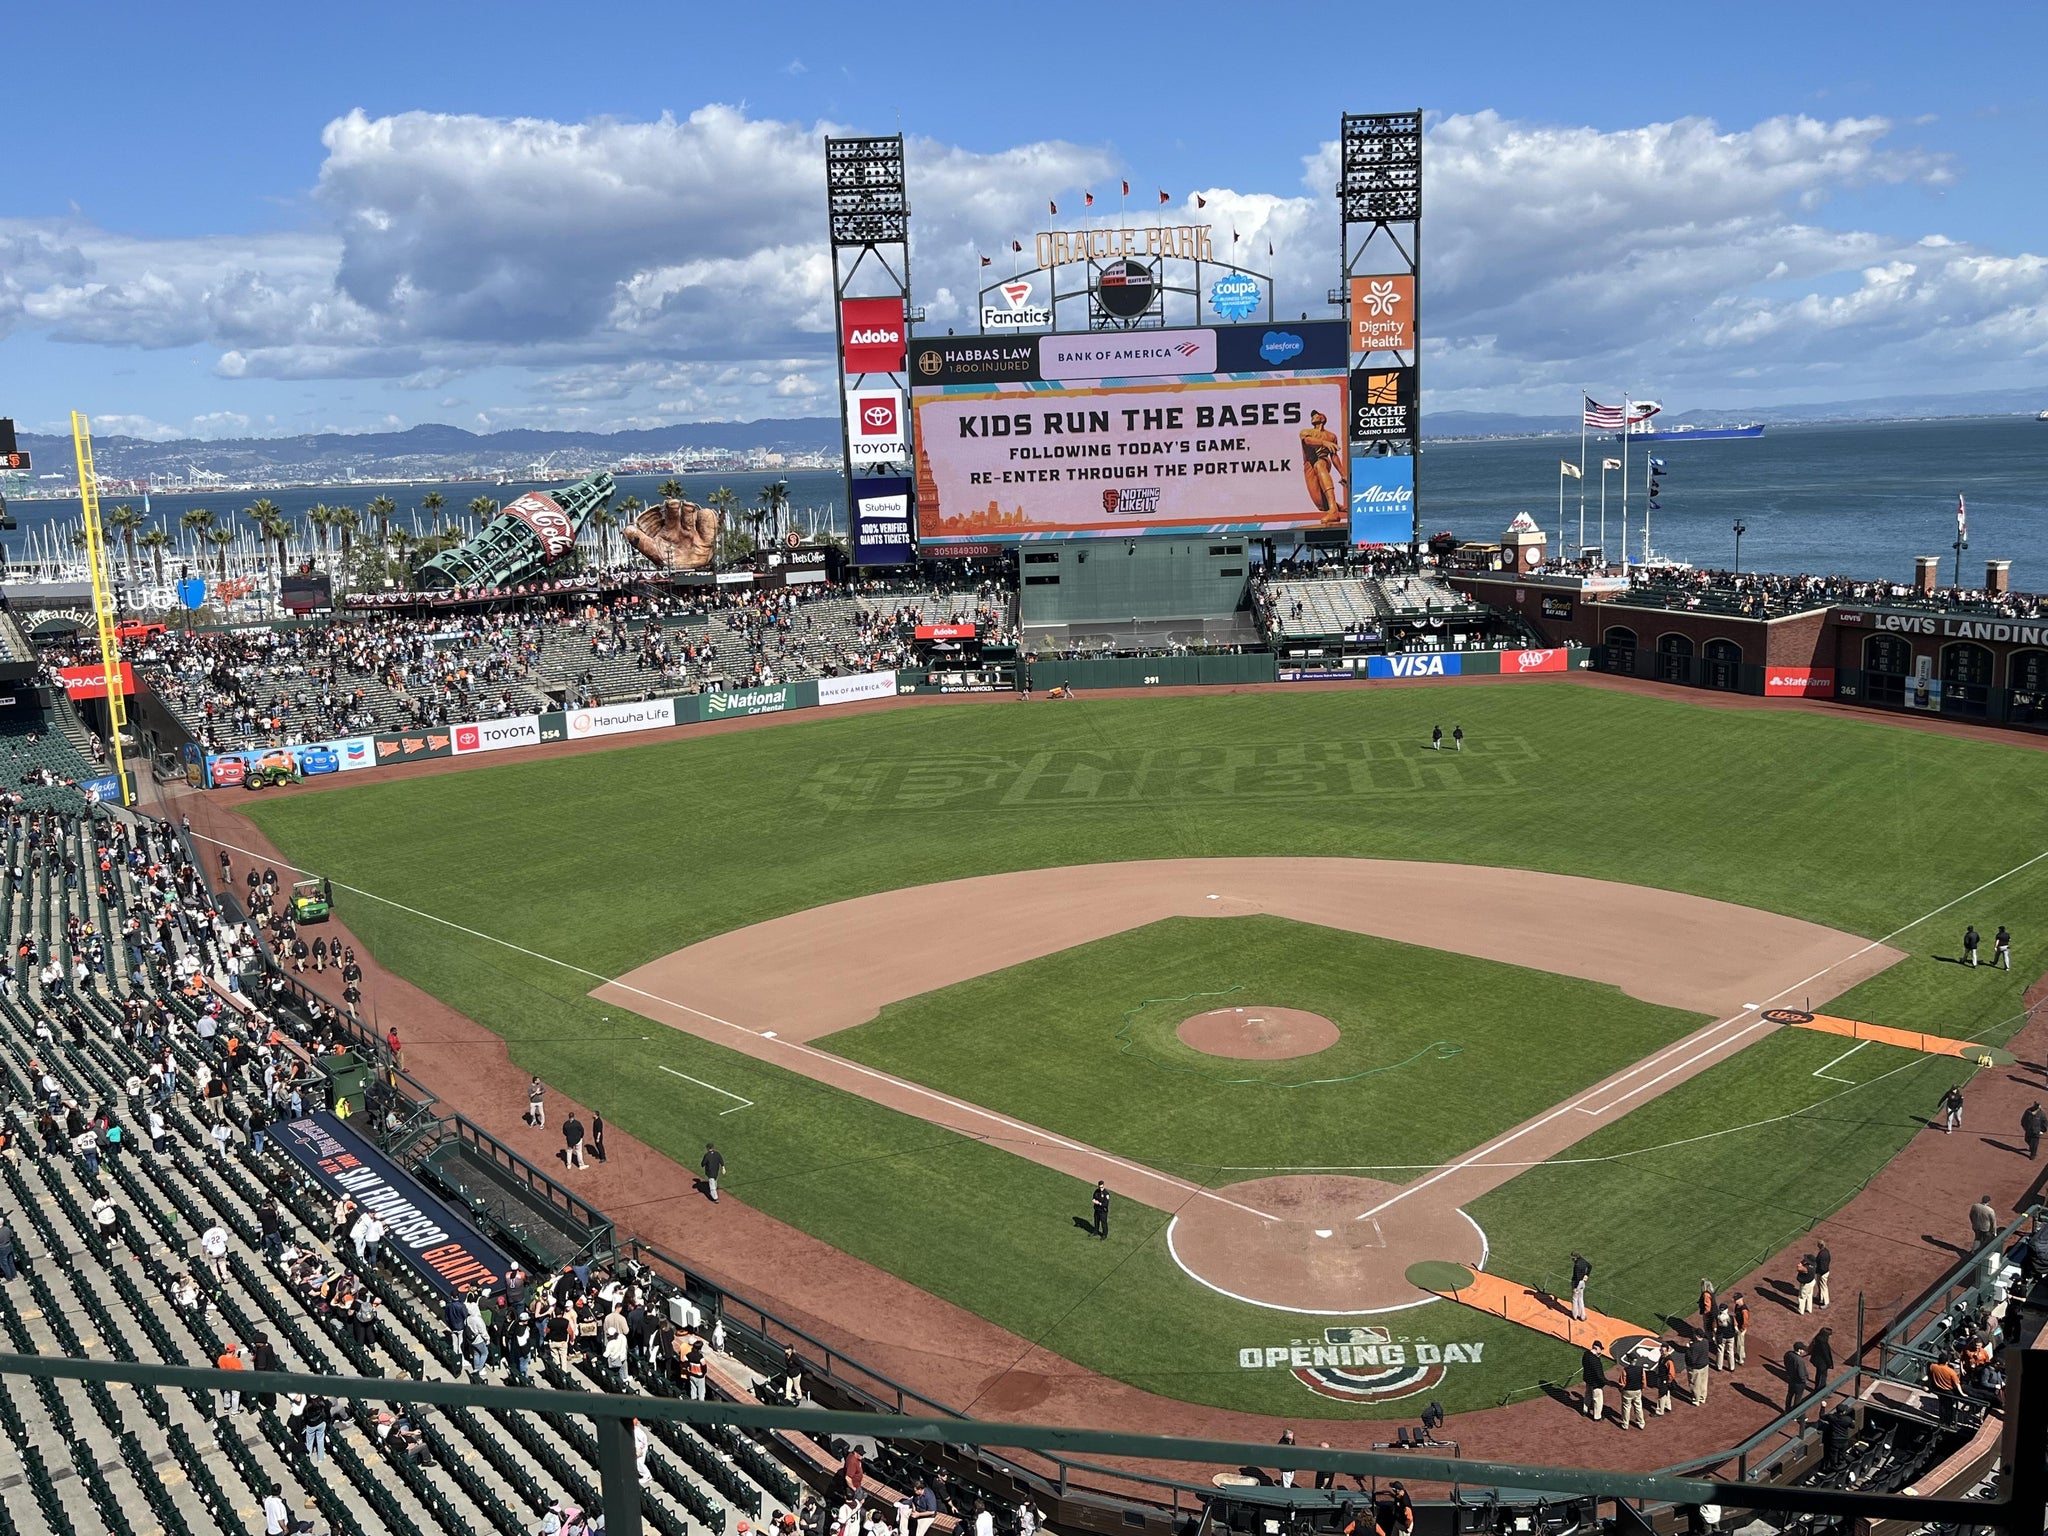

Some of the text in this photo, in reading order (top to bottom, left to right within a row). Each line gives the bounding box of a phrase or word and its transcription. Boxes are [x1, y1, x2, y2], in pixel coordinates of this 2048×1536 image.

[1036, 224, 1214, 269] ORACLE PARK
[1216, 282, 1257, 297] coupa
[984, 309, 1051, 325] Fanatics
[1359, 320, 1404, 336] Dignity
[850, 328, 899, 344] Adobe
[1361, 334, 1402, 348] Health
[1265, 342, 1300, 352] salesforce
[945, 348, 1031, 362] HABBAS LAW
[1058, 349, 1172, 362] BANK OF AMERICA
[1358, 405, 1407, 417] CACHE
[959, 401, 1302, 438] KIDS RUN THE BASES
[1359, 416, 1405, 428] CREEK
[853, 442, 907, 455] TOYOTA
[1009, 438, 1251, 460] FOLLOWING TODAY'S GAME,
[970, 459, 1292, 485] RE-ENTER THROUGH THE PORTWALK
[1121, 488, 1160, 500] NOTHING
[1353, 485, 1413, 503] Alaska
[865, 503, 901, 512] StubHub
[1120, 497, 1159, 511] LIKE IT
[1356, 505, 1407, 513] AIRLINES
[861, 522, 908, 534] 100% VERIFIED
[860, 533, 910, 545] GIANTS TICKETS
[807, 551, 826, 563] Coffee
[934, 546, 988, 556] 30518493010
[21, 606, 97, 633] Ghirardelli
[933, 628, 957, 636] Adobe
[1405, 643, 1444, 652] WELCOME
[1453, 643, 1463, 651] TO
[1519, 653, 1543, 664] AAA
[1579, 660, 1594, 668] 415
[1385, 655, 1444, 677] VISA
[1144, 676, 1159, 685] 391
[820, 689, 839, 697] BANK
[850, 684, 880, 693] AMERICA
[900, 685, 915, 693] 399
[1841, 685, 1856, 695] 365
[727, 688, 786, 709] National
[748, 703, 785, 715] Car Rental
[594, 709, 669, 727] Hanwha Life
[483, 724, 536, 741] TOYOTA
[541, 729, 560, 739] 354
[334, 1166, 499, 1293] SAN FRANCISCO GIANTS
[1290, 1335, 1428, 1346] 20 24
[1239, 1342, 1485, 1368] OPENING DAY
